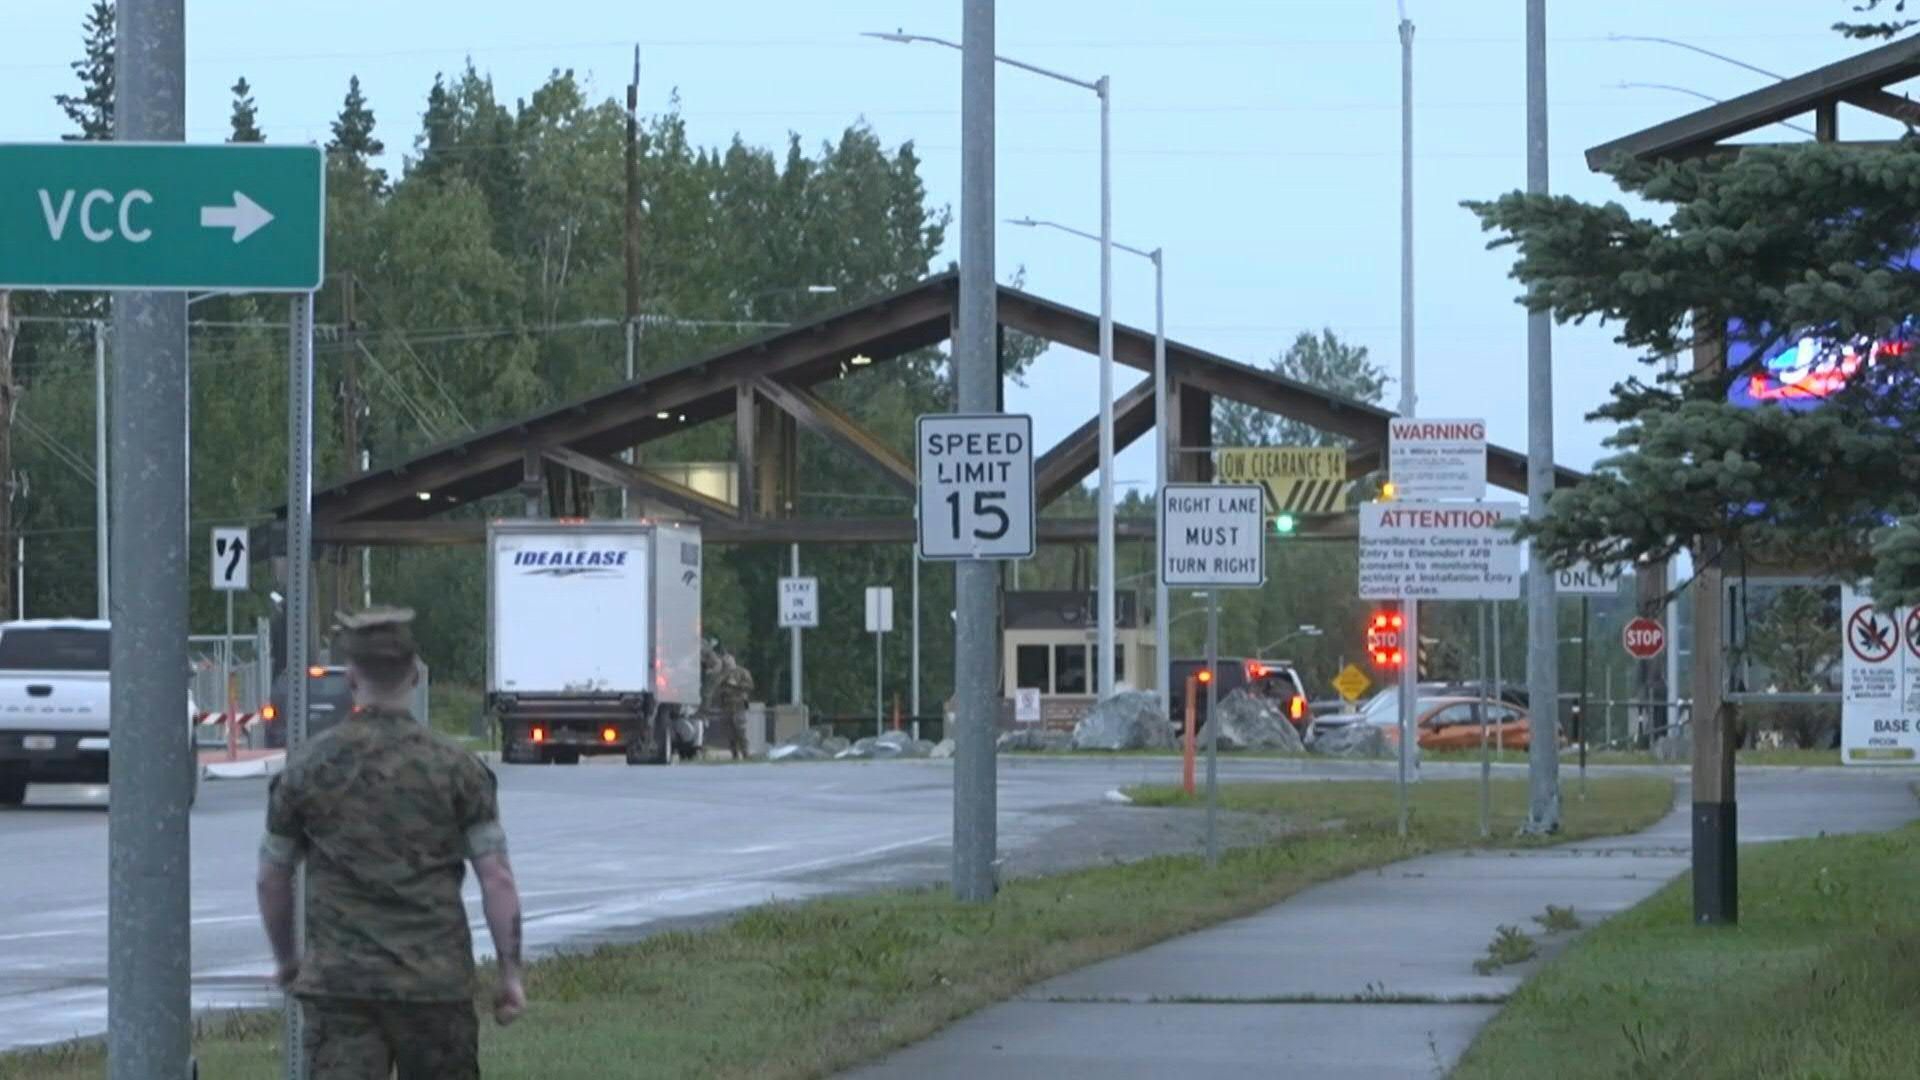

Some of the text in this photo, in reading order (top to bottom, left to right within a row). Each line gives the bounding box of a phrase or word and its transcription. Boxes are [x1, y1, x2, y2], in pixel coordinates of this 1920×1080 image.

[38, 188, 153, 242] VCC
[1392, 424, 1485, 439] WARNING
[928, 432, 1023, 455] SPEED
[1218, 452, 1245, 477] LOW
[1252, 452, 1321, 477] CLEARANCE
[938, 462, 1011, 484] LIMIT
[1168, 498, 1257, 513] RIGHT LANE
[946, 491, 1010, 540] 15
[1380, 510, 1501, 528] ATTENTION
[1186, 527, 1239, 545] MUST
[1430, 536, 1478, 546] Cameras
[514, 551, 628, 565] IDEALEASE
[1360, 549, 1388, 560] Entry
[1469, 548, 1491, 558] AFB
[1168, 558, 1257, 573] TURN RIGHT
[1431, 562, 1489, 573] monitoring
[785, 584, 811, 592] STAY
[785, 612, 812, 621] LANE
[1627, 630, 1661, 646] STOP
[1873, 720, 1910, 732] BASE
